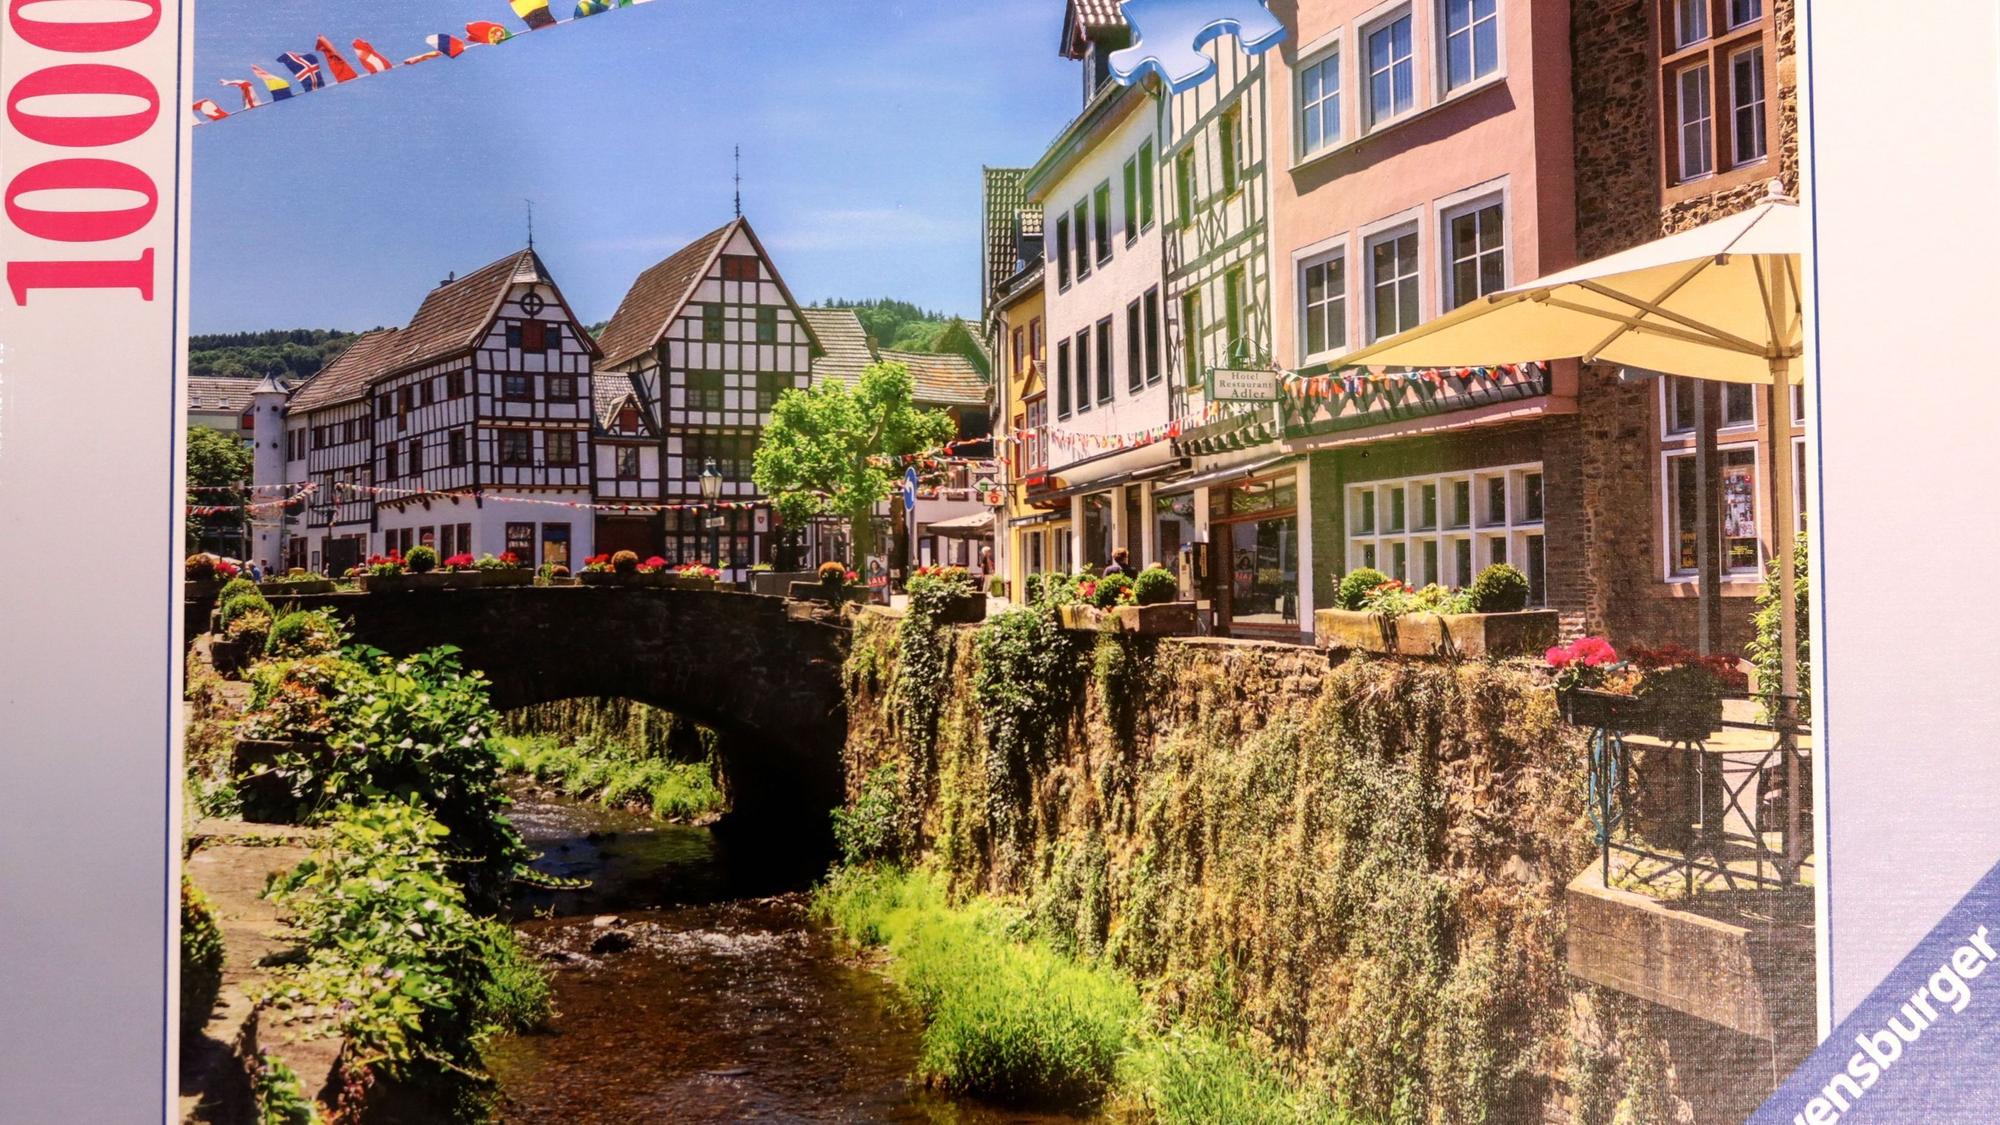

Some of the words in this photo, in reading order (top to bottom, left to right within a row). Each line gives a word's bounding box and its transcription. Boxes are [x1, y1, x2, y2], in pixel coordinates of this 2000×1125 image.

[5, 0, 161, 306] 1000
[1232, 372, 1258, 380] Hotel
[1219, 380, 1273, 388] Restaurant
[1231, 389, 1265, 398] Adler
